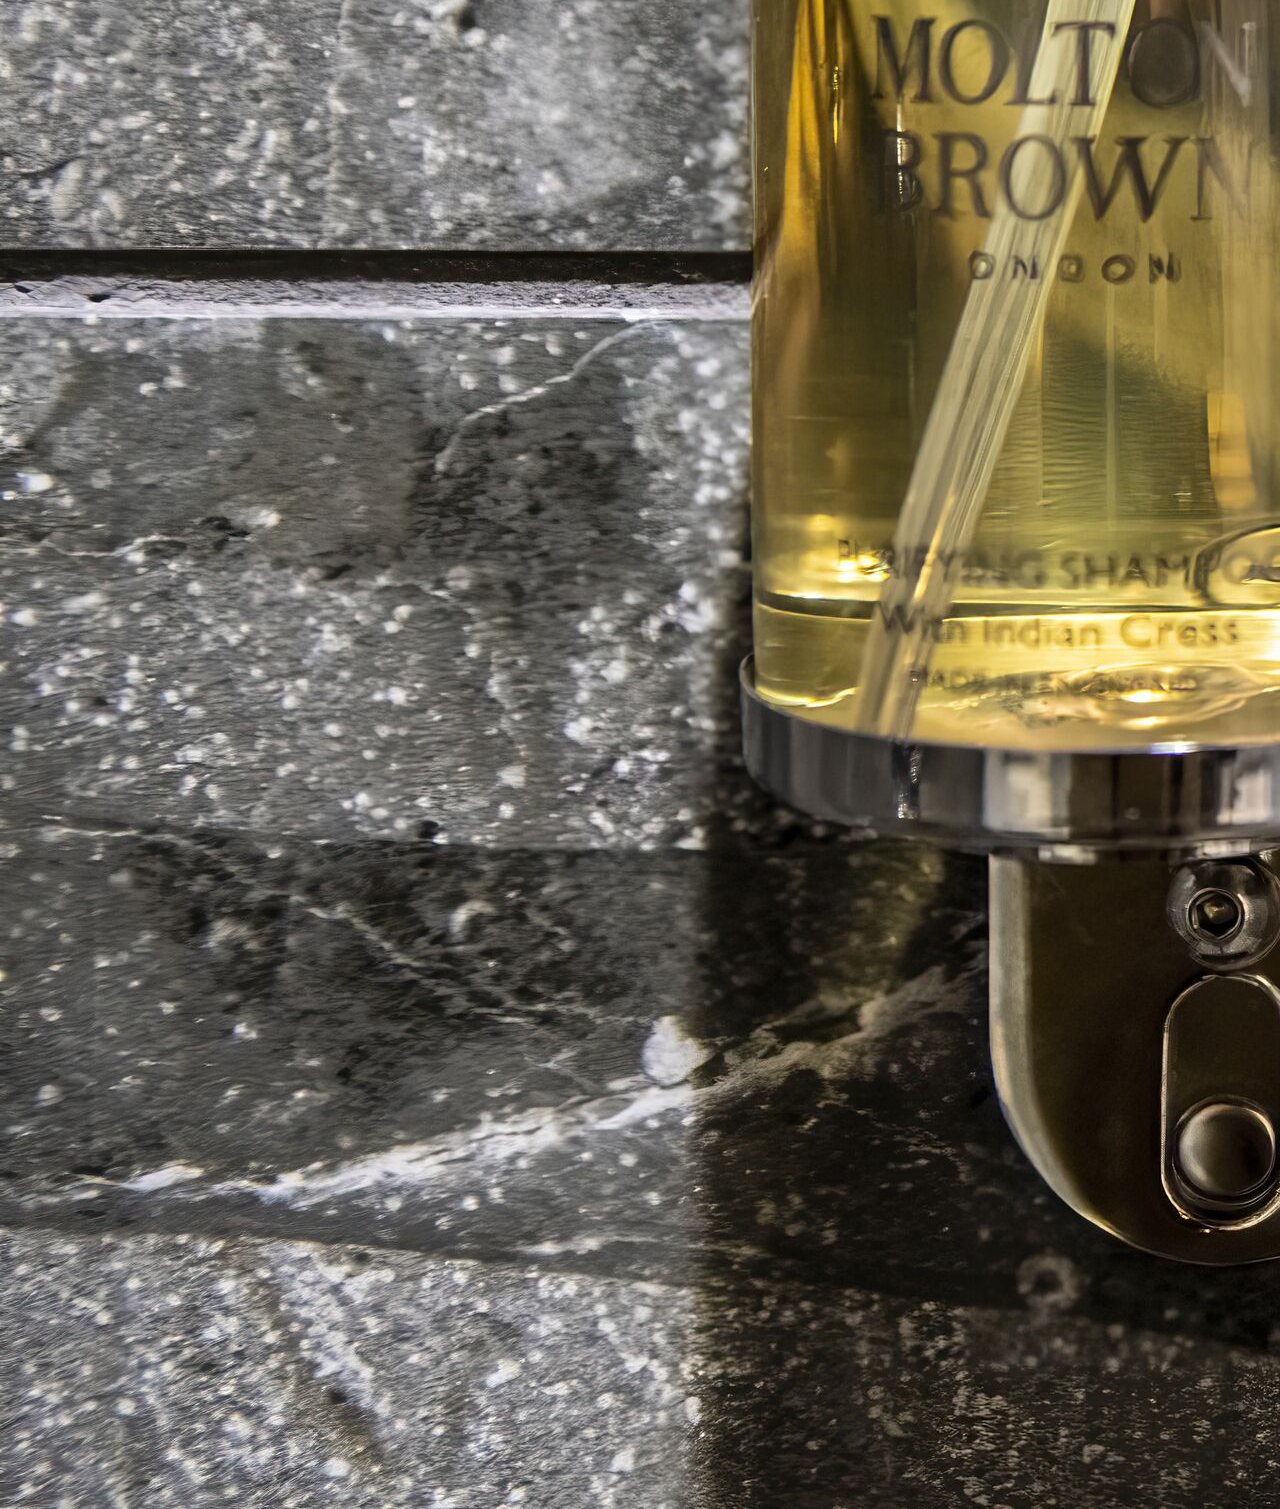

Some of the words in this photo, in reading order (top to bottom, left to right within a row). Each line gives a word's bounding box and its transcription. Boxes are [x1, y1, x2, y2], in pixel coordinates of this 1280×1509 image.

[871, 14, 1257, 109] MOLTON
[874, 128, 1255, 224] BROWN
[983, 615, 1103, 649] Indian
[1119, 613, 1239, 649] Cress
